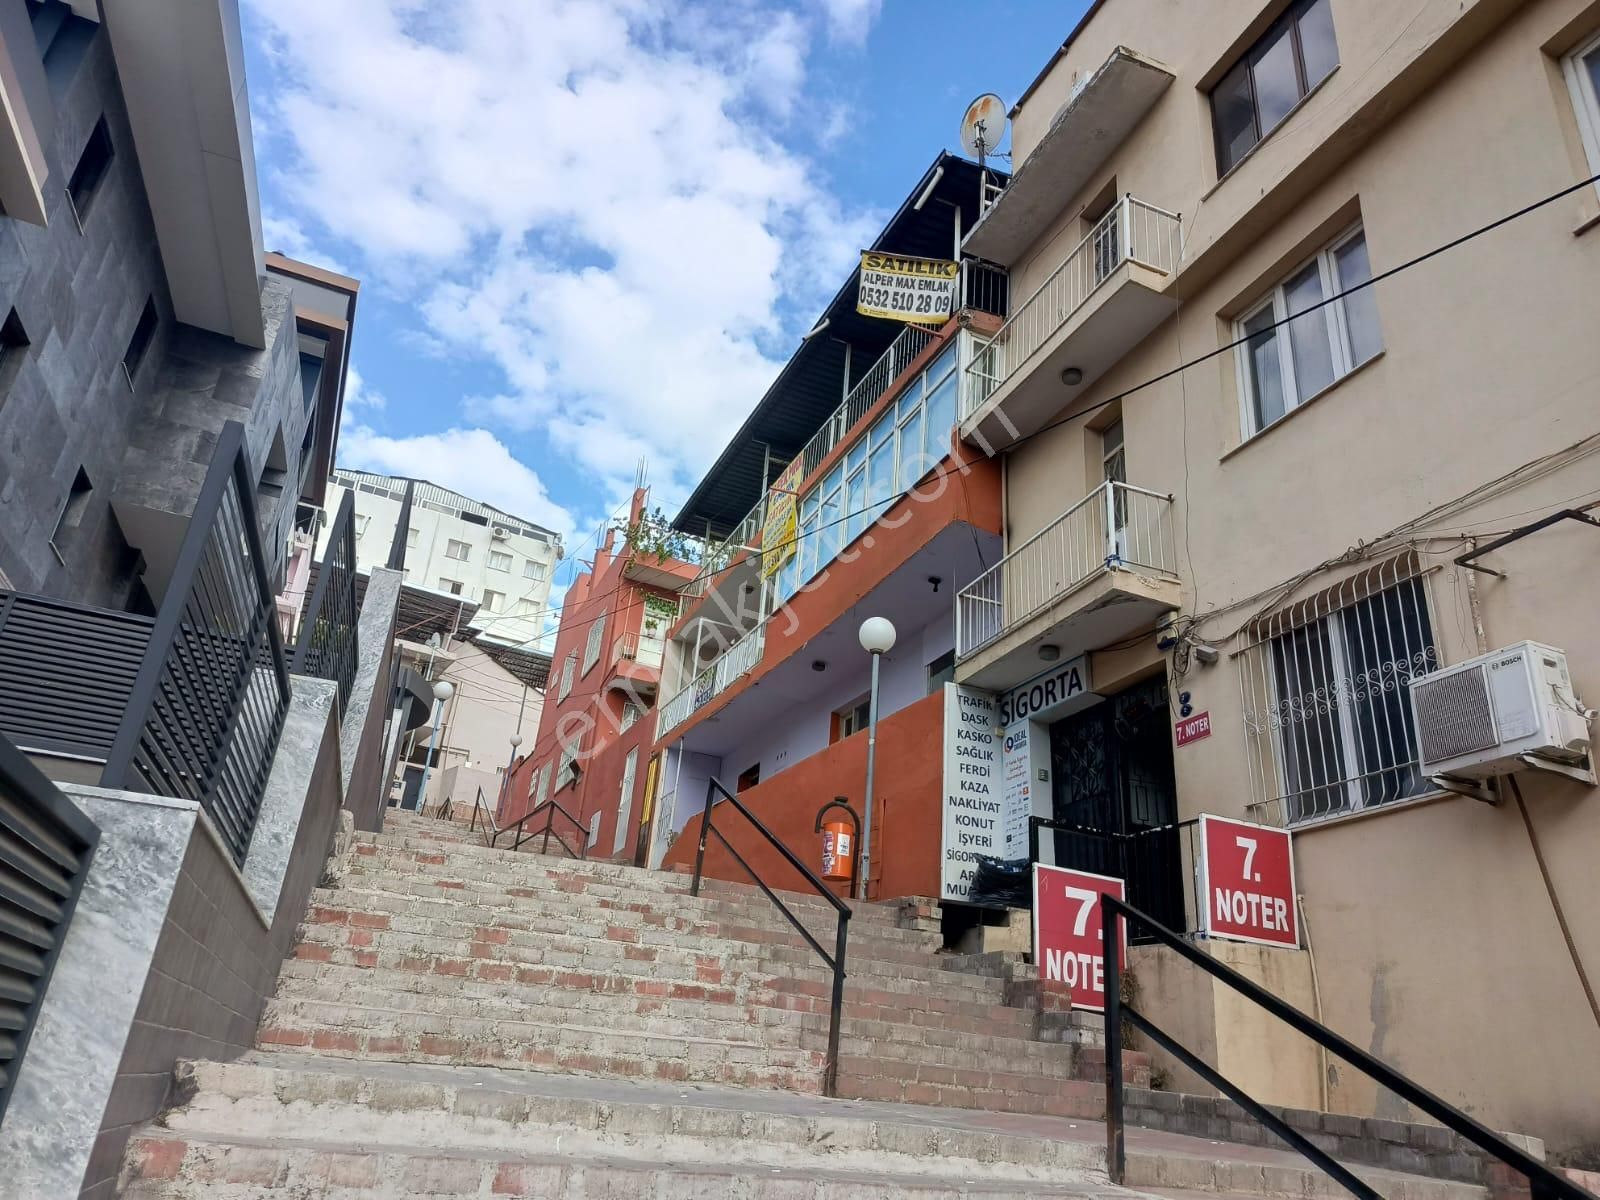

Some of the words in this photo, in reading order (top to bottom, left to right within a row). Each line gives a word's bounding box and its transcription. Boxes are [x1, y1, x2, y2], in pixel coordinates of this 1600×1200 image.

[866, 255, 951, 276] SATILIK
[864, 273, 894, 287] ALPER
[895, 276, 917, 290] MAX
[918, 279, 950, 293] EMLAK
[860, 286, 889, 308] 0532
[891, 291, 914, 311] 510
[916, 294, 932, 313] 28
[934, 295, 950, 313] 09
[1501, 655, 1522, 667] BOSCH
[957, 694, 993, 711] TRAFİK
[1001, 666, 1083, 728] SİGORTA
[961, 712, 989, 726] DASK
[957, 729, 992, 744] KASKO
[1176, 726, 1185, 741] 7.
[1185, 717, 1209, 737] NOTER
[956, 744, 994, 761] SAĞLIK
[959, 761, 991, 778] FERDİ
[960, 779, 990, 795] KAZA
[949, 796, 1001, 814] NAKLİYAT
[955, 814, 995, 830] KONUT
[958, 830, 992, 848] İŞYERİ
[1236, 836, 1261, 882] 7.
[1215, 887, 1289, 932] NOTER
[1046, 948, 1105, 992] NOTE
